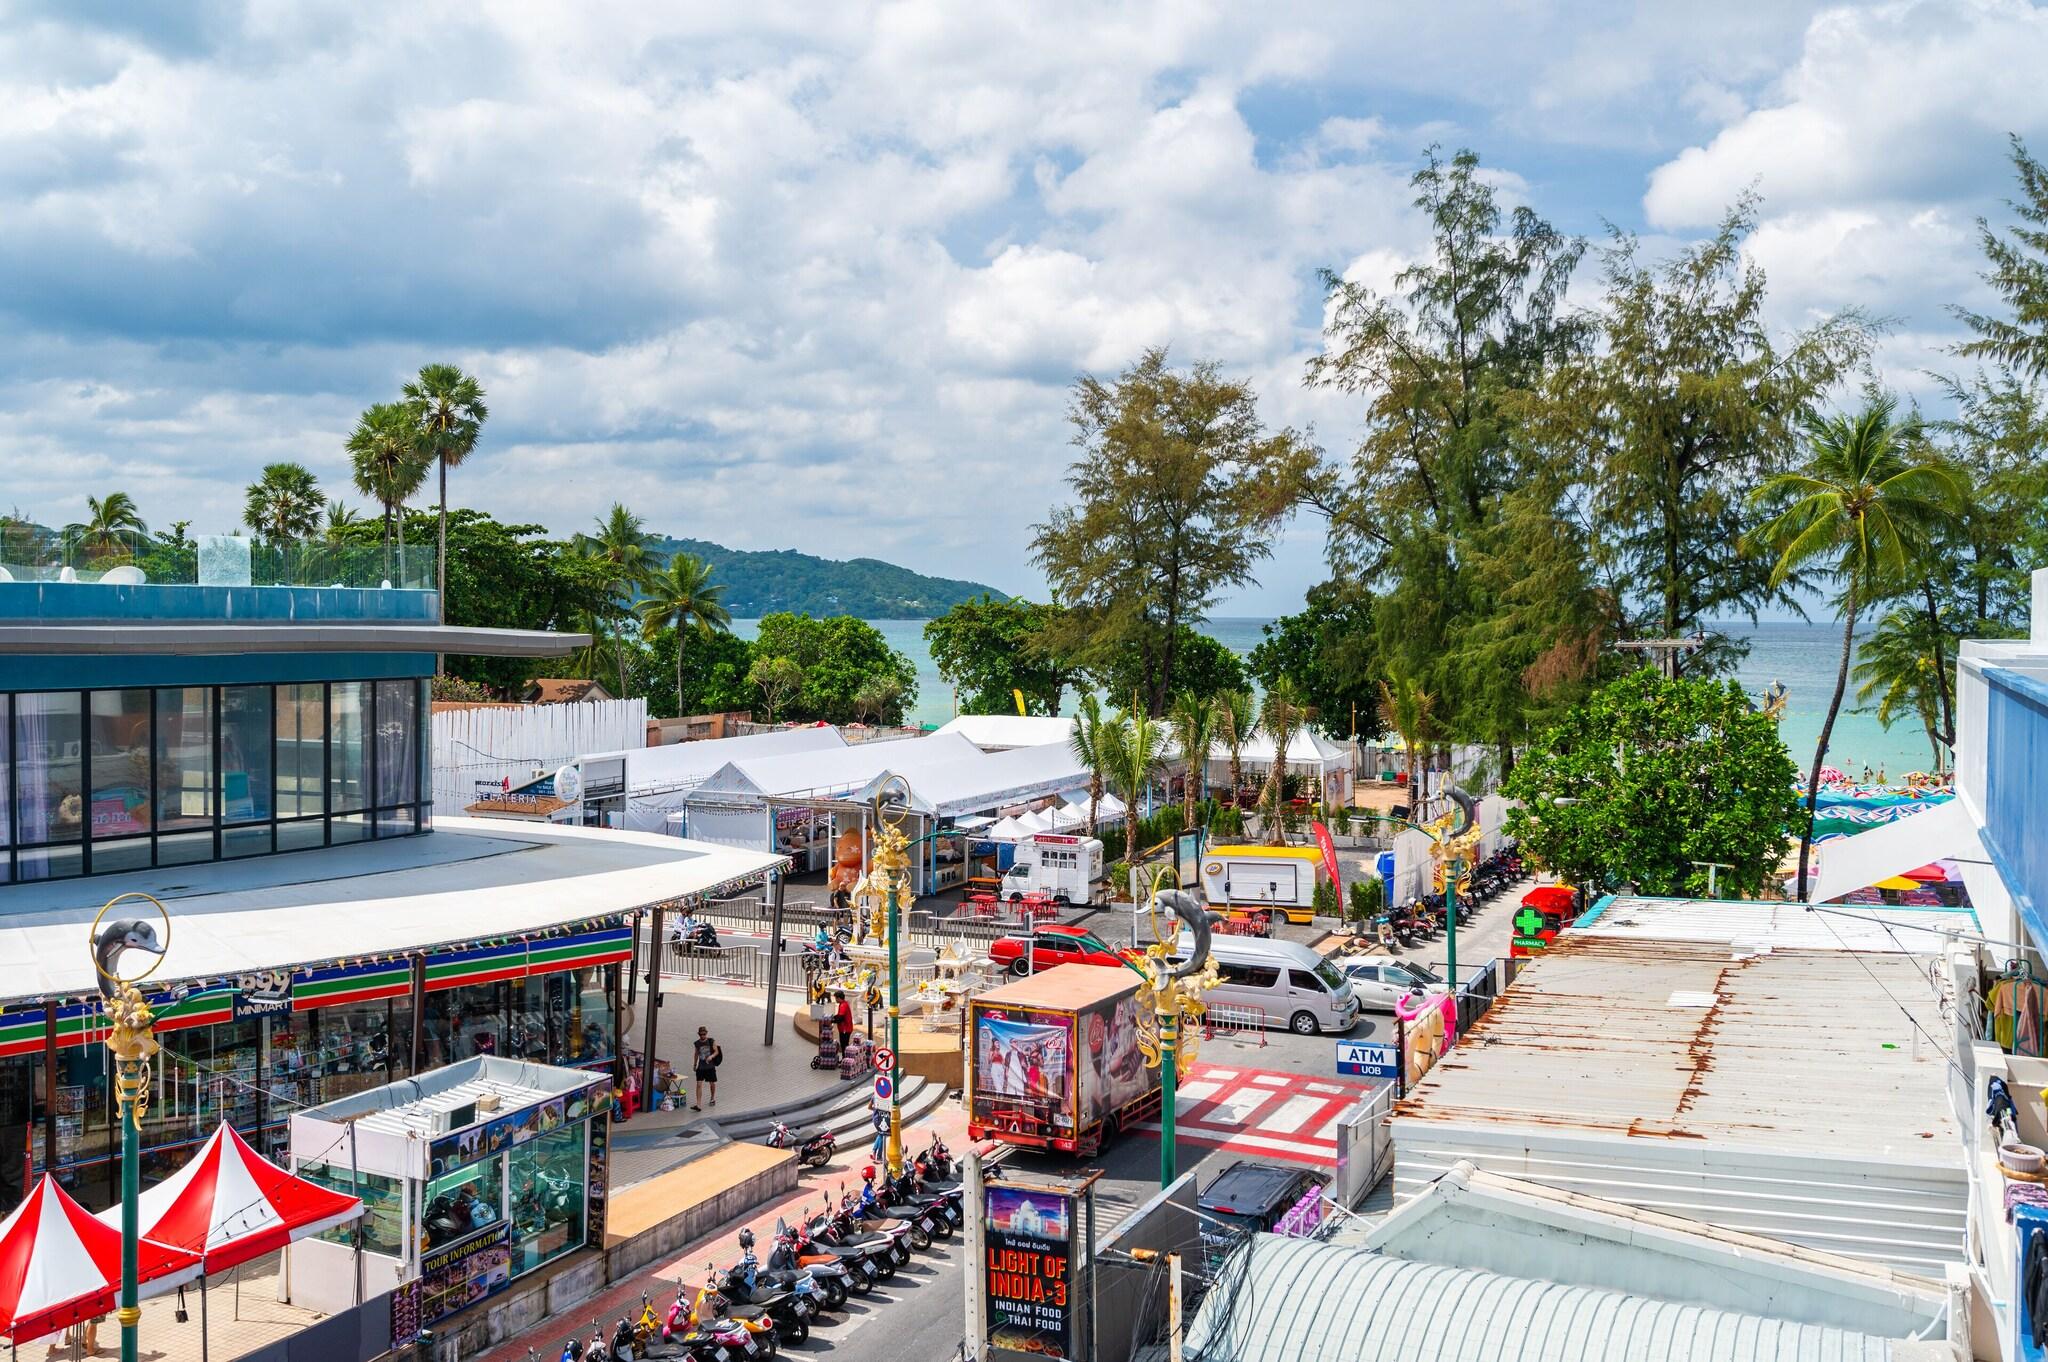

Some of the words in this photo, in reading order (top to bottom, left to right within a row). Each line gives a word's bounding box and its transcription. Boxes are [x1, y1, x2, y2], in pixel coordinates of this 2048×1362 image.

[237, 1002, 288, 1016] MINIMART
[1349, 1048, 1384, 1064] ATM
[1361, 1065, 1382, 1075] UOB
[425, 1254, 449, 1272] TOUR
[450, 1230, 506, 1261] INFORMATION
[989, 1248, 1040, 1275] LIGHT
[1043, 1255, 1067, 1279] OF
[995, 1300, 1031, 1314] INDIAN
[1035, 1306, 1062, 1319] FOOD
[1008, 1314, 1032, 1327] THAI
[1035, 1319, 1062, 1331] FOOD
